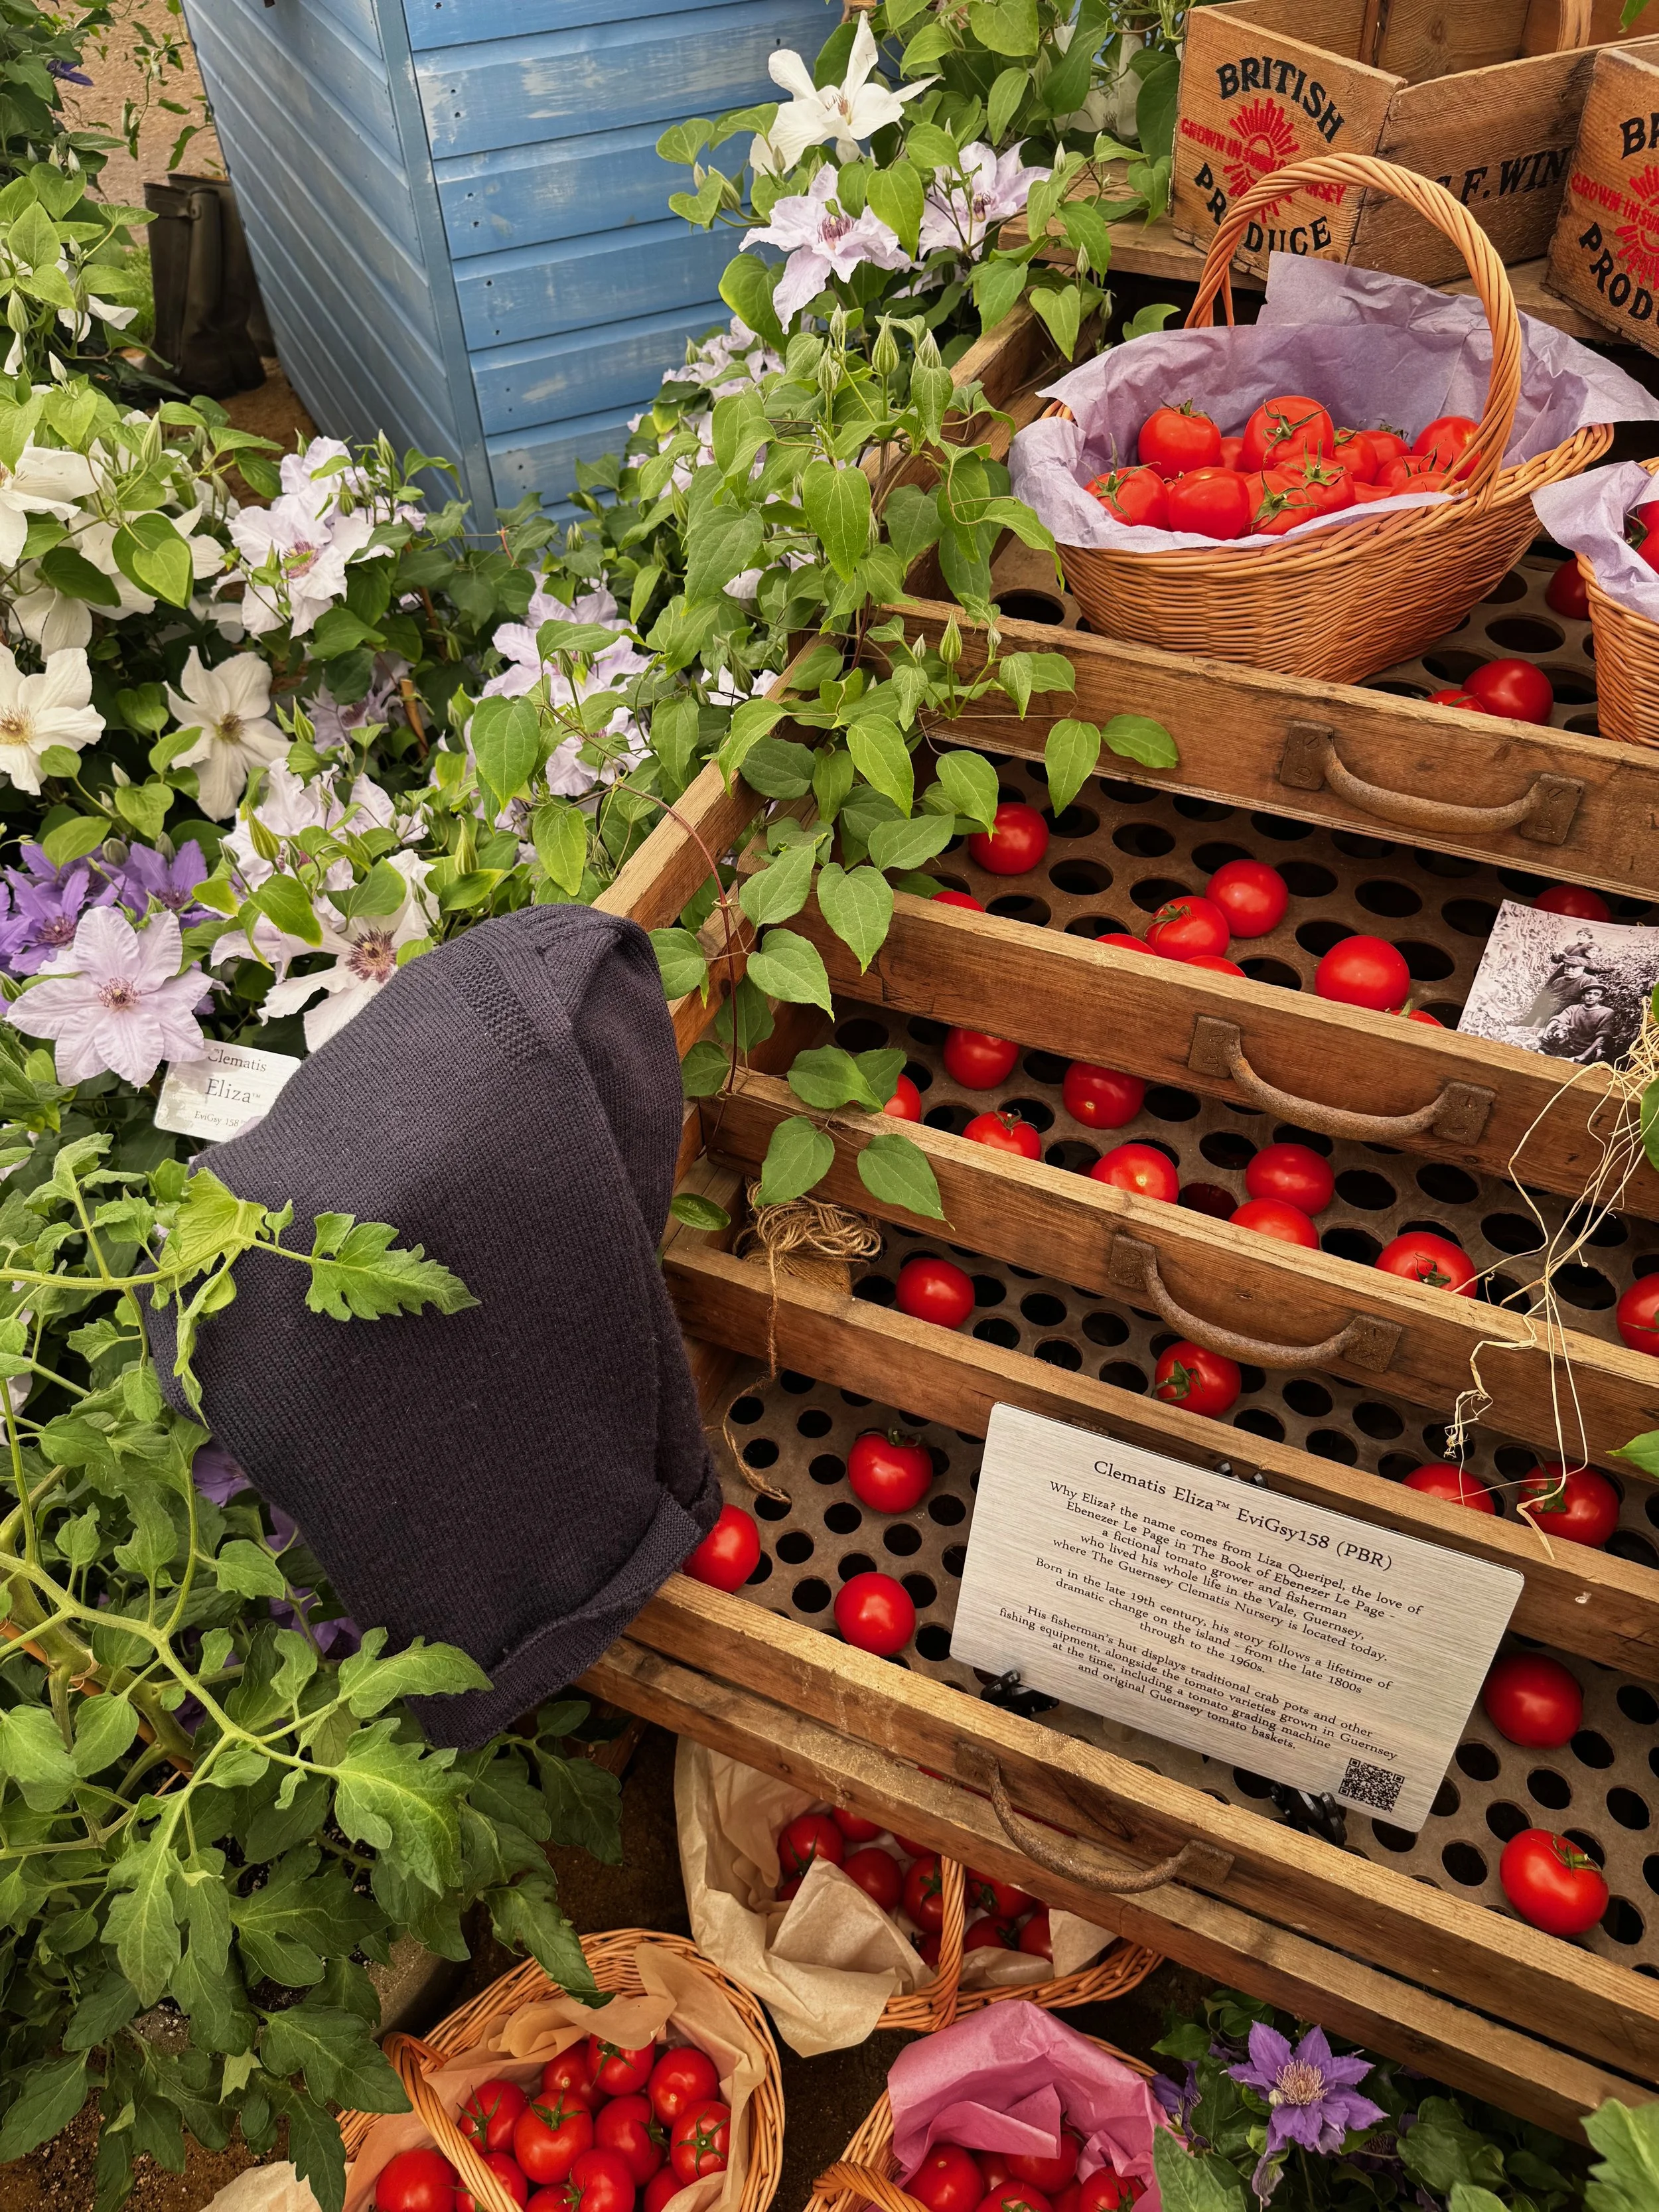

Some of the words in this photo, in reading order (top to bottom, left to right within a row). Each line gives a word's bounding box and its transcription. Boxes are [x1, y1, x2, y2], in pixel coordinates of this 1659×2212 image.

[1216, 56, 1345, 143] BRITISH
[1227, 138, 1243, 159] IN
[1194, 162, 1332, 256] PRDUCE
[1571, 173, 1623, 213] GROWN
[1623, 198, 1641, 223] IN
[1579, 222, 1659, 328] PROD
[207, 1048, 267, 1072] Clematis
[194, 1110, 222, 1126] EviGsy
[1050, 1481, 1078, 1500] Why
[1082, 1492, 1116, 1511] Eliza?
[1120, 1506, 1138, 1519] the
[1143, 1516, 1175, 1532] name
[1181, 1530, 1218, 1546] comes
[1222, 1540, 1251, 1559] from
[1257, 1552, 1282, 1569] Liza
[1288, 1564, 1345, 1591] Queripel,
[1352, 1585, 1372, 1598] the
[1376, 1591, 1402, 1609] love
[1407, 1605, 1424, 1615] of
[1066, 1501, 1119, 1526] Ebenezer
[1123, 1520, 1137, 1532] Le
[1141, 1526, 1170, 1545] Page
[1174, 1539, 1186, 1550] in
[1192, 1544, 1215, 1560] The
[1220, 1554, 1252, 1572] Book
[1256, 1569, 1271, 1578] of
[1273, 1572, 1330, 1598] Ebenezer
[1334, 1593, 1350, 1605] Le
[1354, 1600, 1384, 1618] Page
[1094, 1461, 1166, 1495] Clematis
[1236, 1507, 1330, 1548] EviGsy158
[1336, 1541, 1392, 1572] (PBR)
[1036, 1557, 1062, 1574] Born
[1067, 1569, 1078, 1580] in
[1084, 1575, 1101, 1587] the
[1106, 1582, 1125, 1596] late
[1131, 1593, 1155, 1607] 19th
[1160, 1605, 1206, 1627] century,
[1212, 1619, 1229, 1633] his
[1234, 1631, 1263, 1647] story
[1268, 1640, 1311, 1662] follows
[1327, 1660, 1373, 1684] lifetime
[1378, 1681, 1394, 1690] of
[1053, 1539, 1086, 1556] where
[1092, 1550, 1114, 1566] The
[1118, 1561, 1173, 1588] Guernsey
[1178, 1582, 1230, 1606] Clematis
[1234, 1601, 1283, 1627] Nursery
[1288, 1620, 1297, 1630] is
[1302, 1624, 1346, 1647] located
[1351, 1643, 1387, 1662] today.
[1080, 1536, 1104, 1548] who
[1109, 1542, 1137, 1560] lived
[1141, 1554, 1158, 1568] his
[1163, 1564, 1198, 1582] whole
[1202, 1575, 1221, 1590] life
[1226, 1585, 1237, 1596] in
[1244, 1591, 1262, 1603] the
[1268, 1598, 1297, 1617] Vale,
[1303, 1611, 1364, 1640] Guernsey,
[1113, 1530, 1161, 1555] fictional
[1165, 1550, 1206, 1570] tomato
[1210, 1568, 1254, 1587] grower
[1258, 1585, 1281, 1597] and
[1285, 1591, 1346, 1619] fisherman
[999, 1607, 1035, 1631] fishing
[1040, 1626, 1100, 1653] equipment,
[1105, 1649, 1157, 1672] alongside
[1162, 1668, 1180, 1681] the
[1185, 1678, 1224, 1697] tomato
[1230, 1694, 1276, 1716] varieties
[1279, 1714, 1317, 1731] grown
[1323, 1726, 1334, 1737] in
[1340, 1733, 1398, 1761] Guernsey
[1027, 1605, 1046, 1619] His
[1118, 1638, 1137, 1653] hut
[1141, 1648, 1186, 1670] displays
[1191, 1667, 1250, 1694] traditional
[1254, 1692, 1279, 1704] crab
[1283, 1702, 1309, 1715] pots
[1313, 1712, 1336, 1725] and
[1340, 1722, 1373, 1737] other
[1056, 1578, 1104, 1602] dramatic
[1109, 1597, 1149, 1619] change
[1153, 1615, 1167, 1625] on
[1173, 1621, 1191, 1633] the
[1195, 1629, 1230, 1647] island
[1244, 1645, 1272, 1662] from
[1278, 1658, 1297, 1670] the
[1301, 1664, 1323, 1680] late
[1328, 1676, 1362, 1693] 1800s
[1140, 1621, 1185, 1645] through
[1190, 1641, 1201, 1650] to
[1206, 1646, 1224, 1659] the
[1230, 1655, 1265, 1673] 1960s.
[1067, 1646, 1084, 1658] the
[1089, 1655, 1116, 1671] time,
[1121, 1666, 1173, 1694] including
[1189, 1692, 1228, 1711] tomato
[1232, 1710, 1277, 1732] grading
[1281, 1727, 1331, 1748] machine
[1078, 1664, 1098, 1676] and
[1103, 1674, 1145, 1694] original
[1150, 1690, 1203, 1716] Guernsey
[1207, 1712, 1247, 1731] tomato
[1252, 1726, 1295, 1749] baskets.
